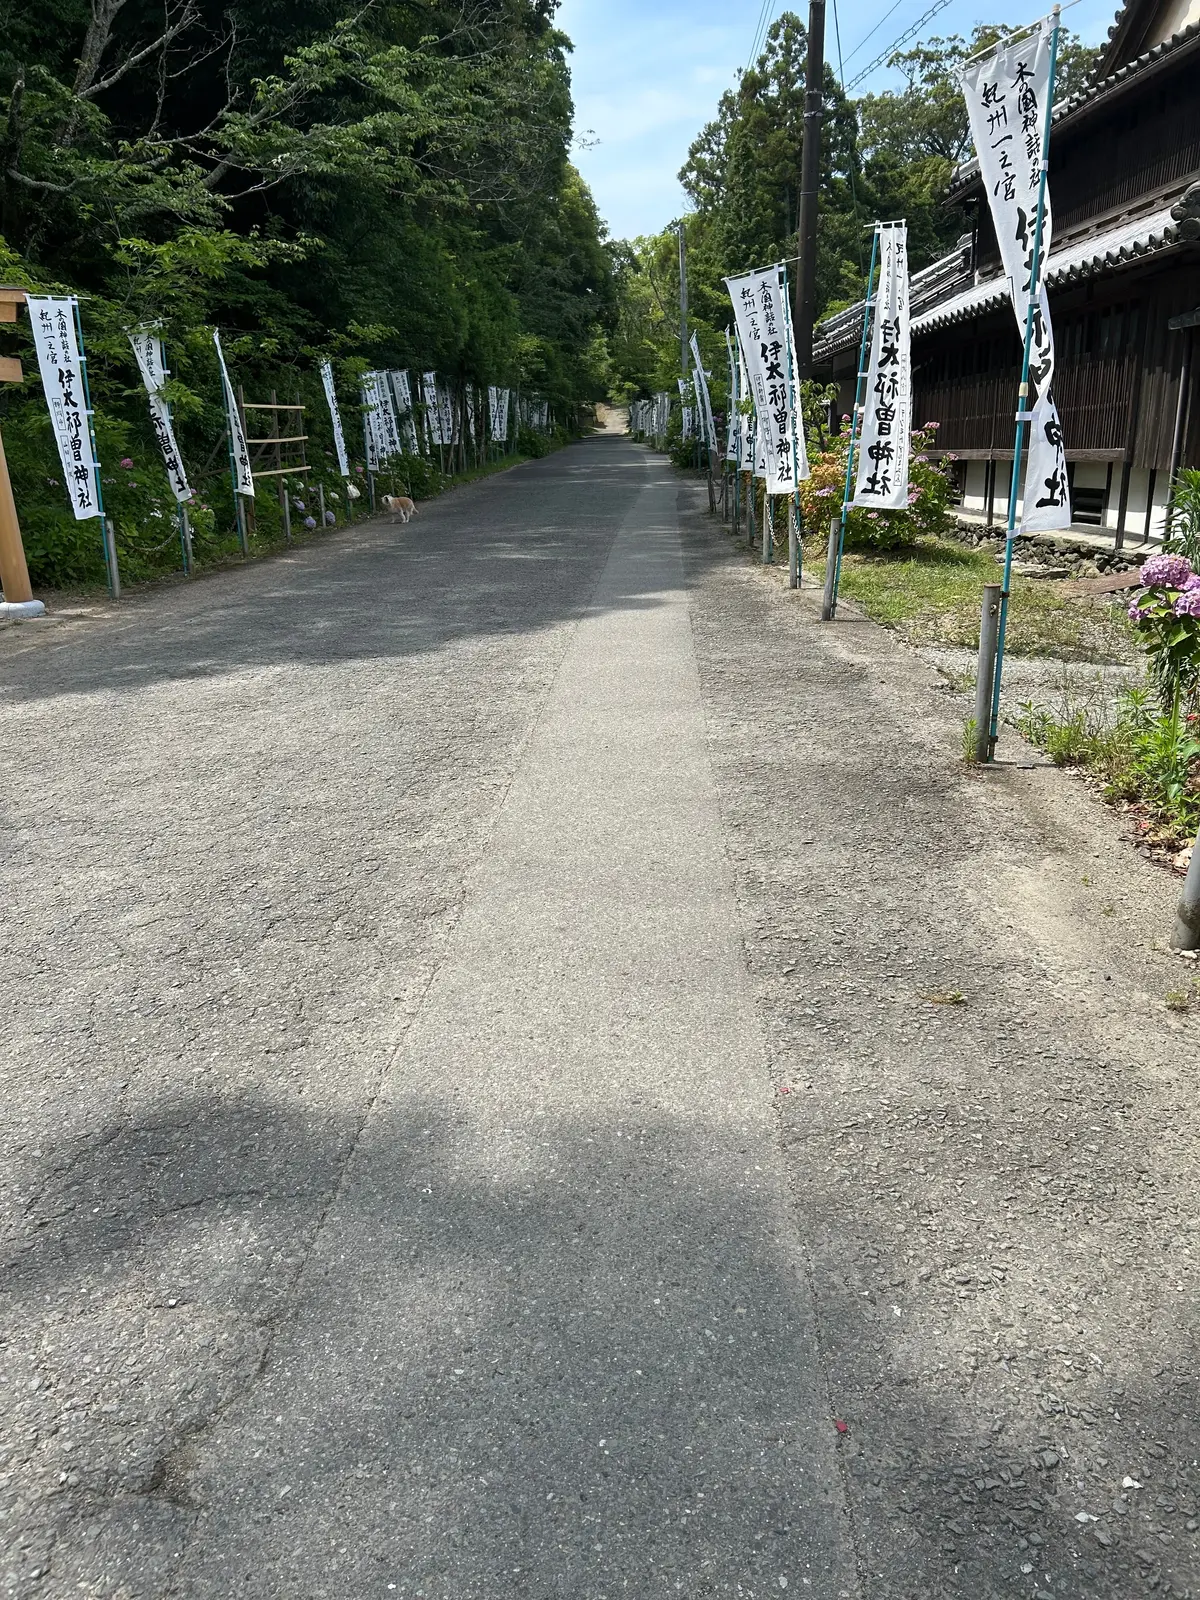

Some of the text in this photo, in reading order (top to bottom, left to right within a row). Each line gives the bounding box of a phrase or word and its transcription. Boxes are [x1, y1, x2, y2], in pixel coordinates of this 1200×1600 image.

[981, 82, 1017, 202] 紀州一之宮
[39, 309, 58, 365] 紀州一之宮
[740, 288, 760, 341] 紀州一之宮
[58, 368, 92, 510] 伊太祁曽神社
[760, 340, 792, 482] 伊太祁曽神社
